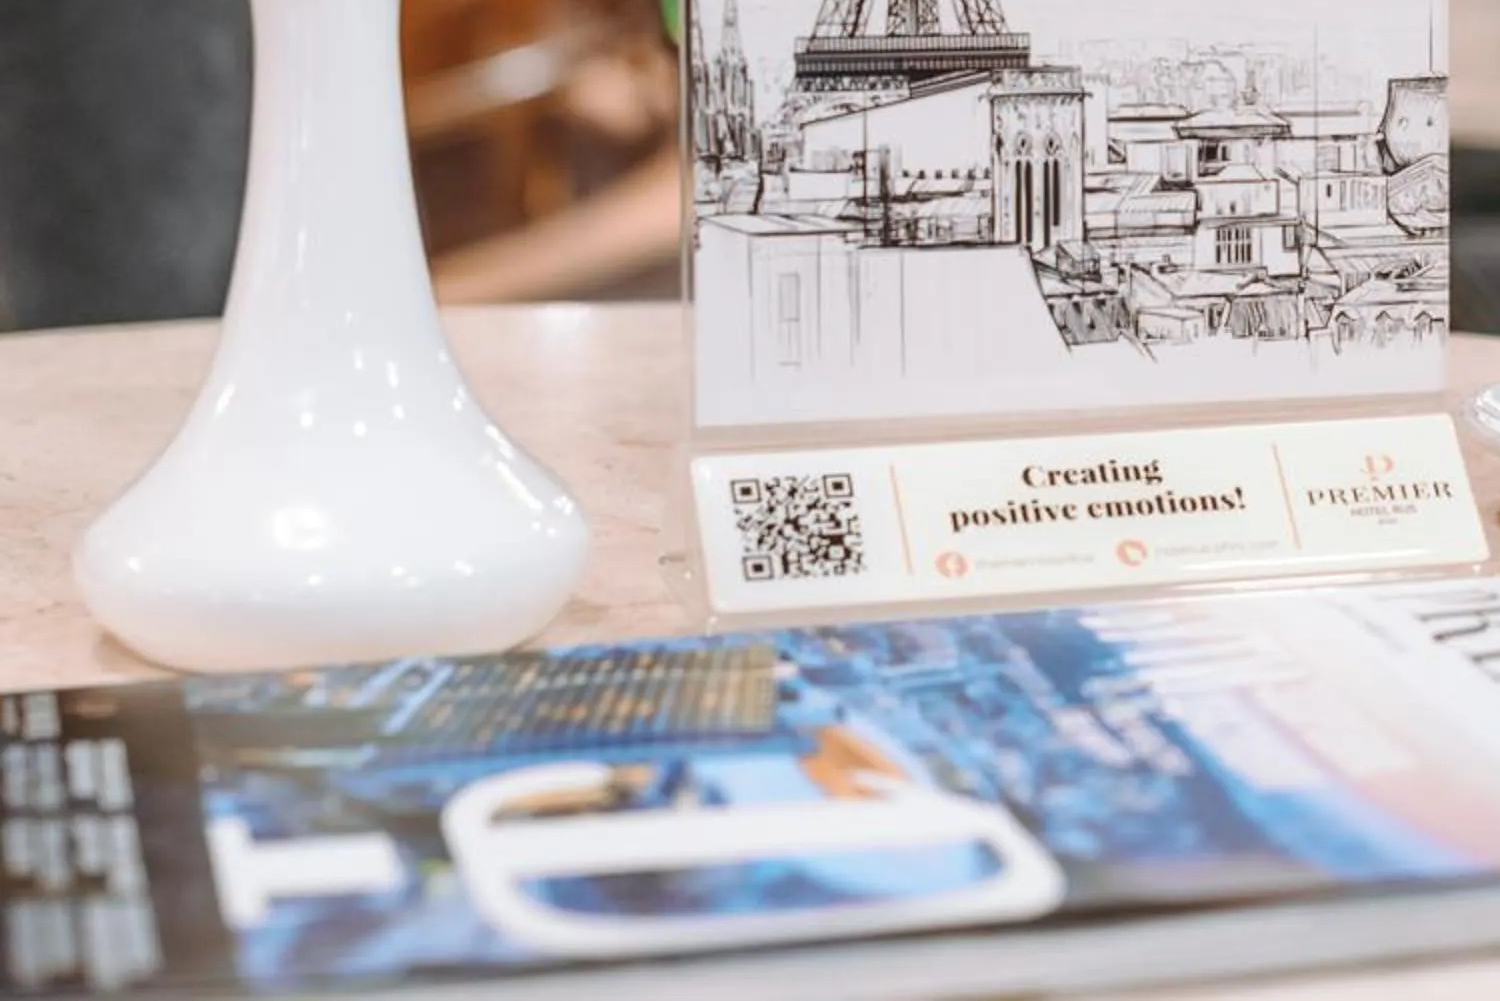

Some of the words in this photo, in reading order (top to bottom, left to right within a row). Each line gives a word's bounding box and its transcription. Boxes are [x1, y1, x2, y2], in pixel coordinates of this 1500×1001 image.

[1021, 459, 1164, 487] Creating
[1306, 480, 1453, 507] PREMIER
[949, 499, 1078, 533] positive
[1086, 486, 1247, 520] emotions!
